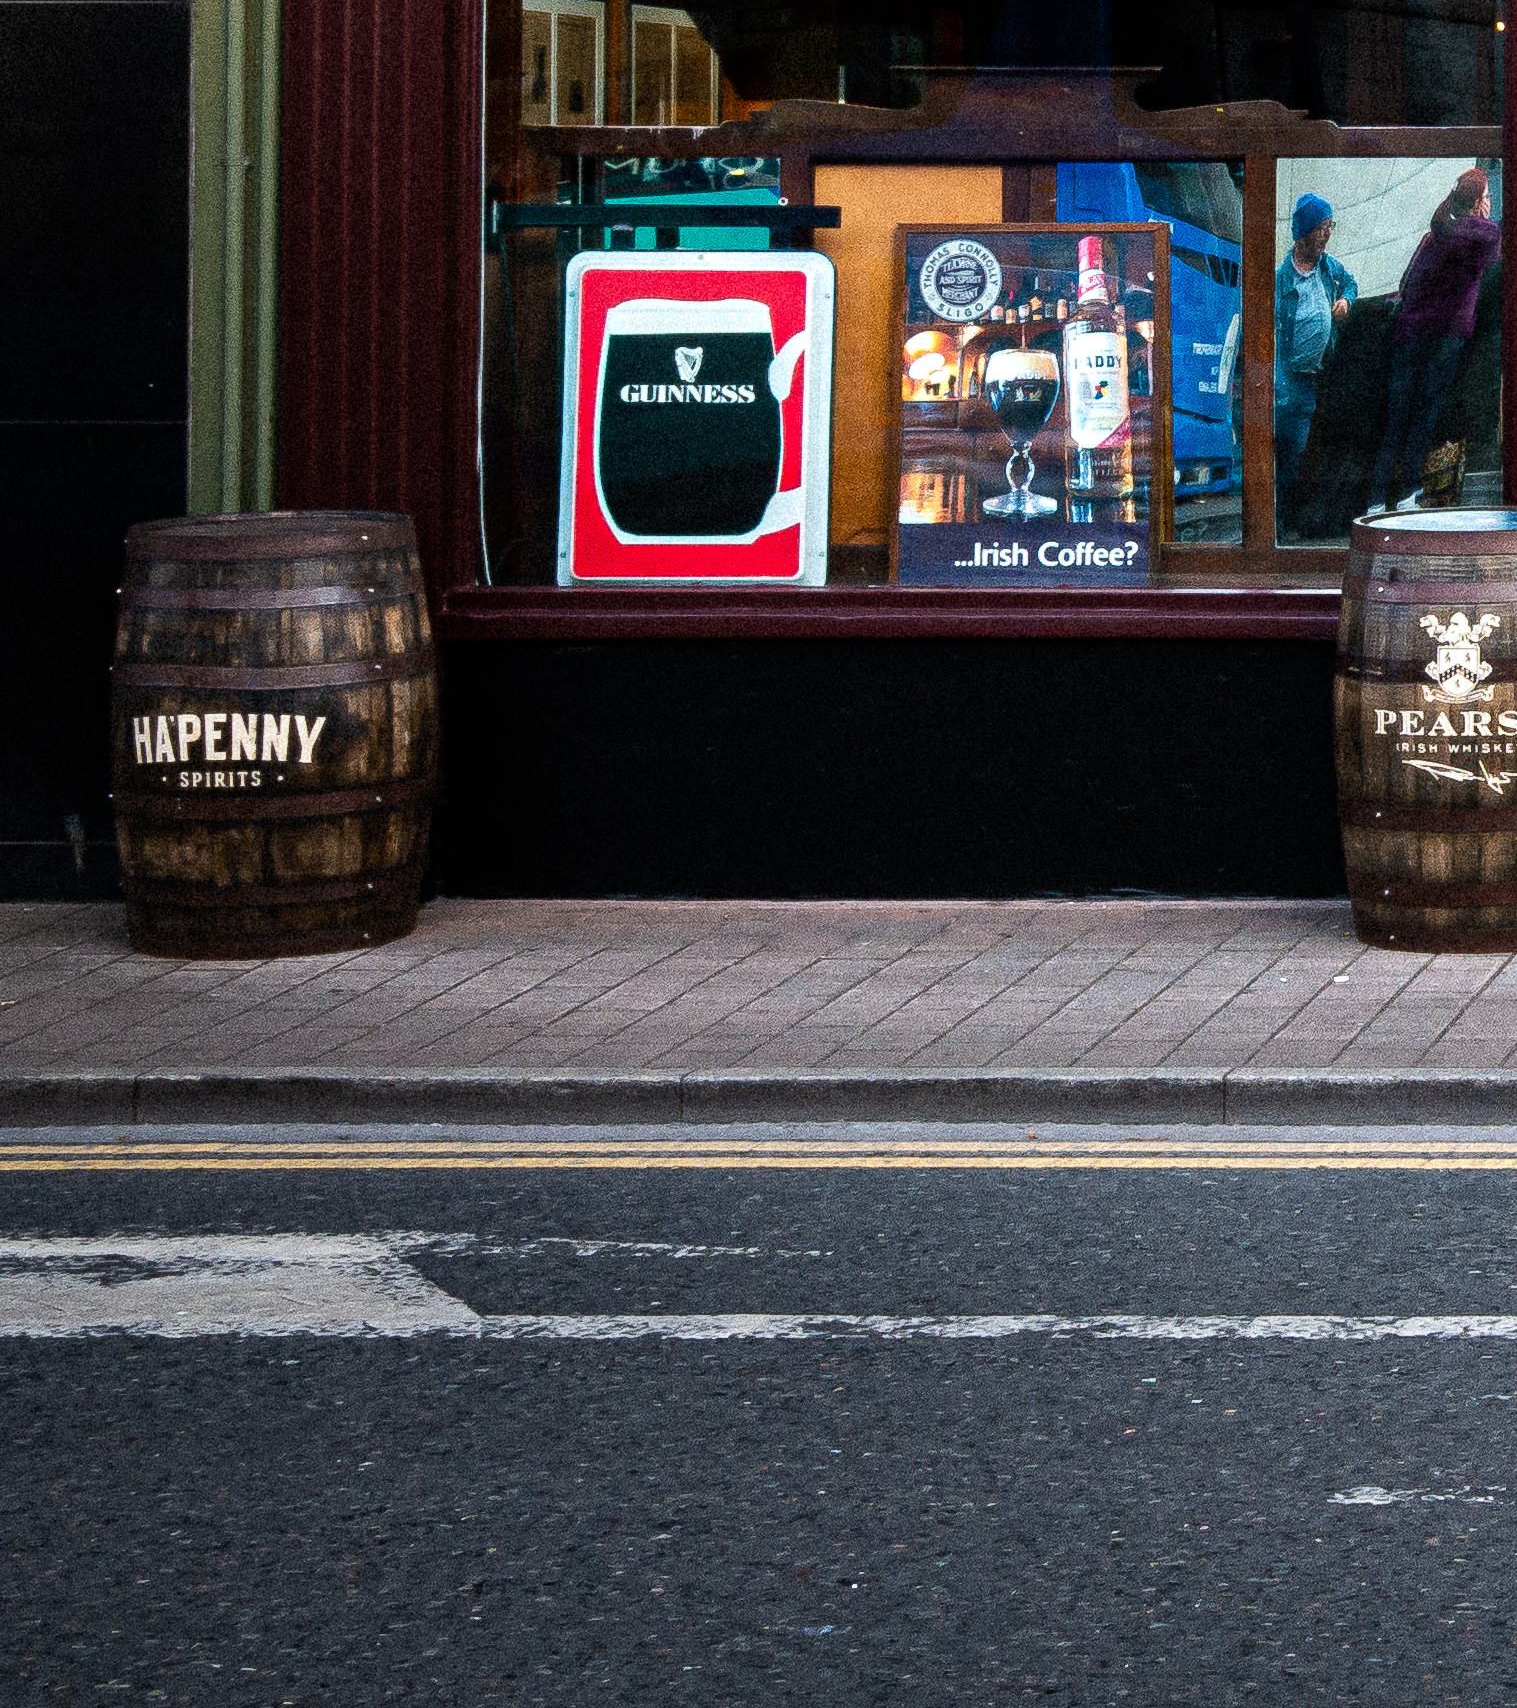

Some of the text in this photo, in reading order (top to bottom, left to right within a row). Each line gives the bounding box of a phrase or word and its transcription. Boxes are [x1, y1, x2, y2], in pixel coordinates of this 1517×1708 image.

[936, 302, 984, 318] SLIGO
[620, 384, 756, 404] GUINNESS
[1038, 542, 1138, 567] Coffee?
[132, 713, 326, 764] HA'PENNY
[1396, 743, 1438, 753] IRISH
[179, 771, 261, 788] SPIRITS
